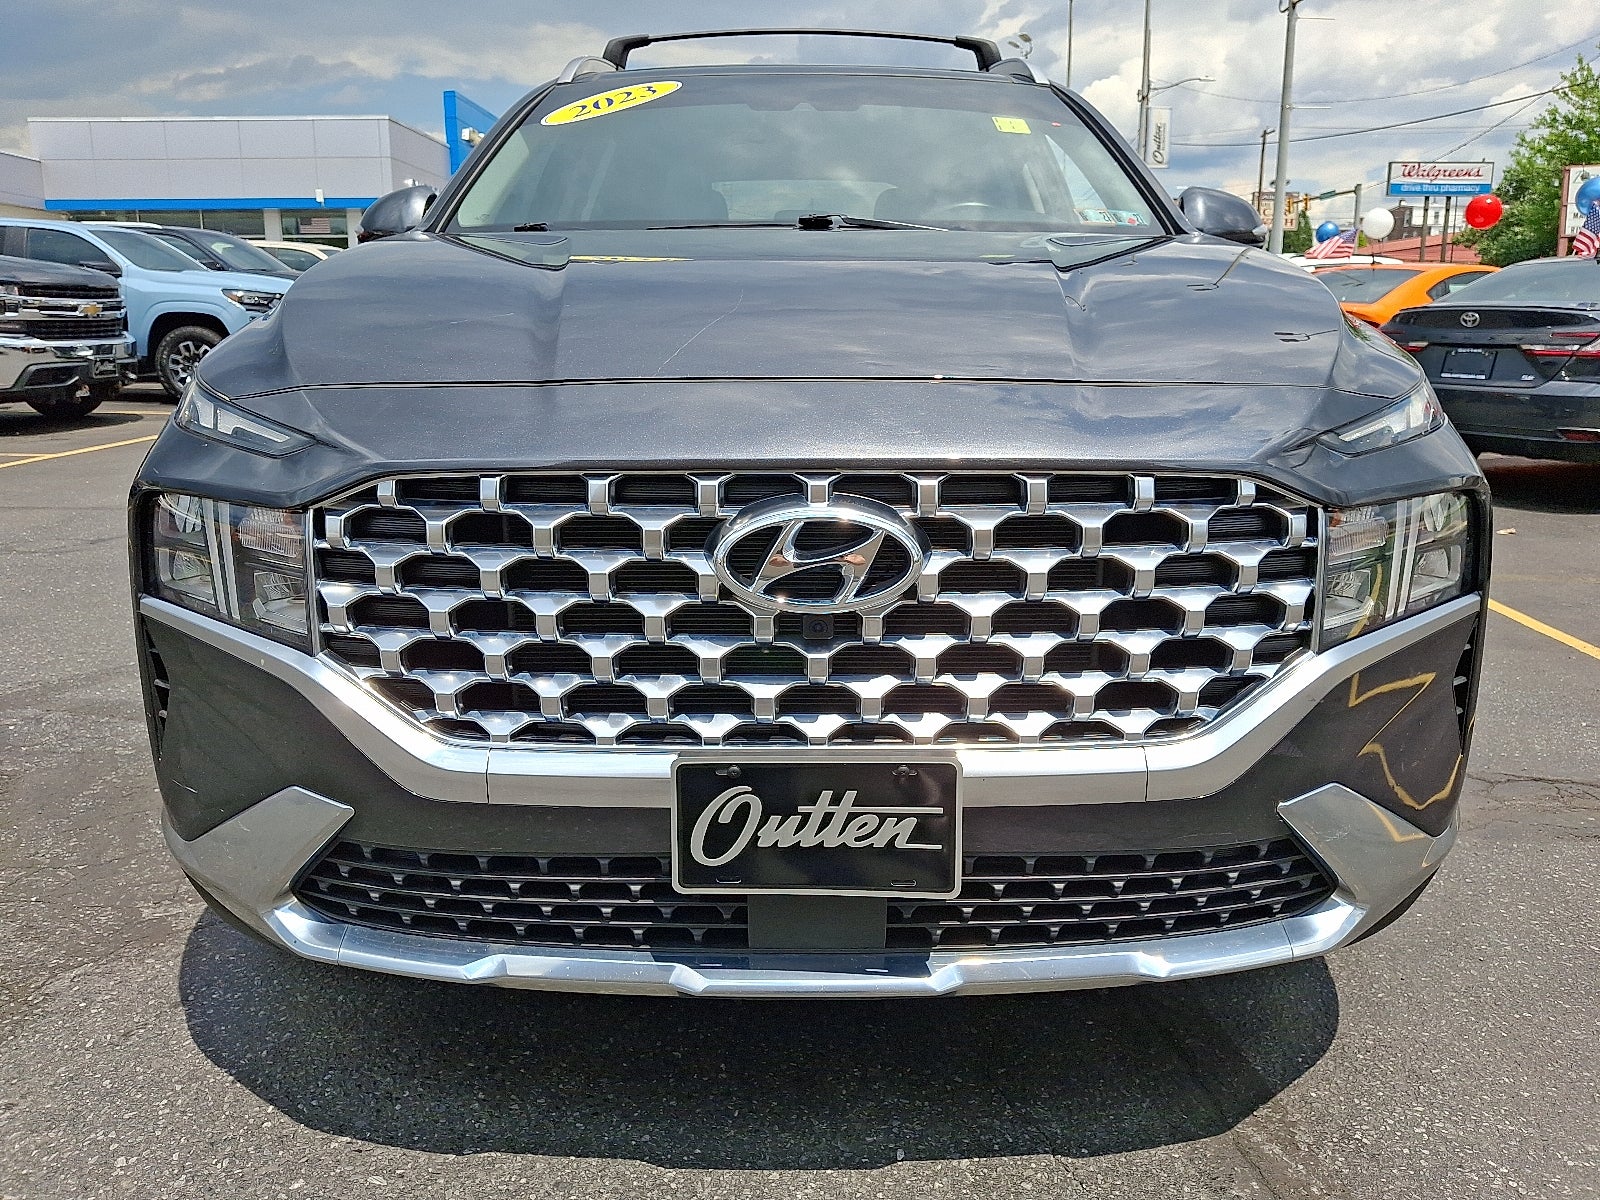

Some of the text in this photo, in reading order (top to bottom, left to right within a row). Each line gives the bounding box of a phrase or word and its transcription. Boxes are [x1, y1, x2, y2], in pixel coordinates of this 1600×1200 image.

[568, 86, 657, 118] 2023
[1401, 163, 1483, 182] Walgreens
[1441, 184, 1481, 194] pharmacy
[690, 785, 944, 867] Outten
